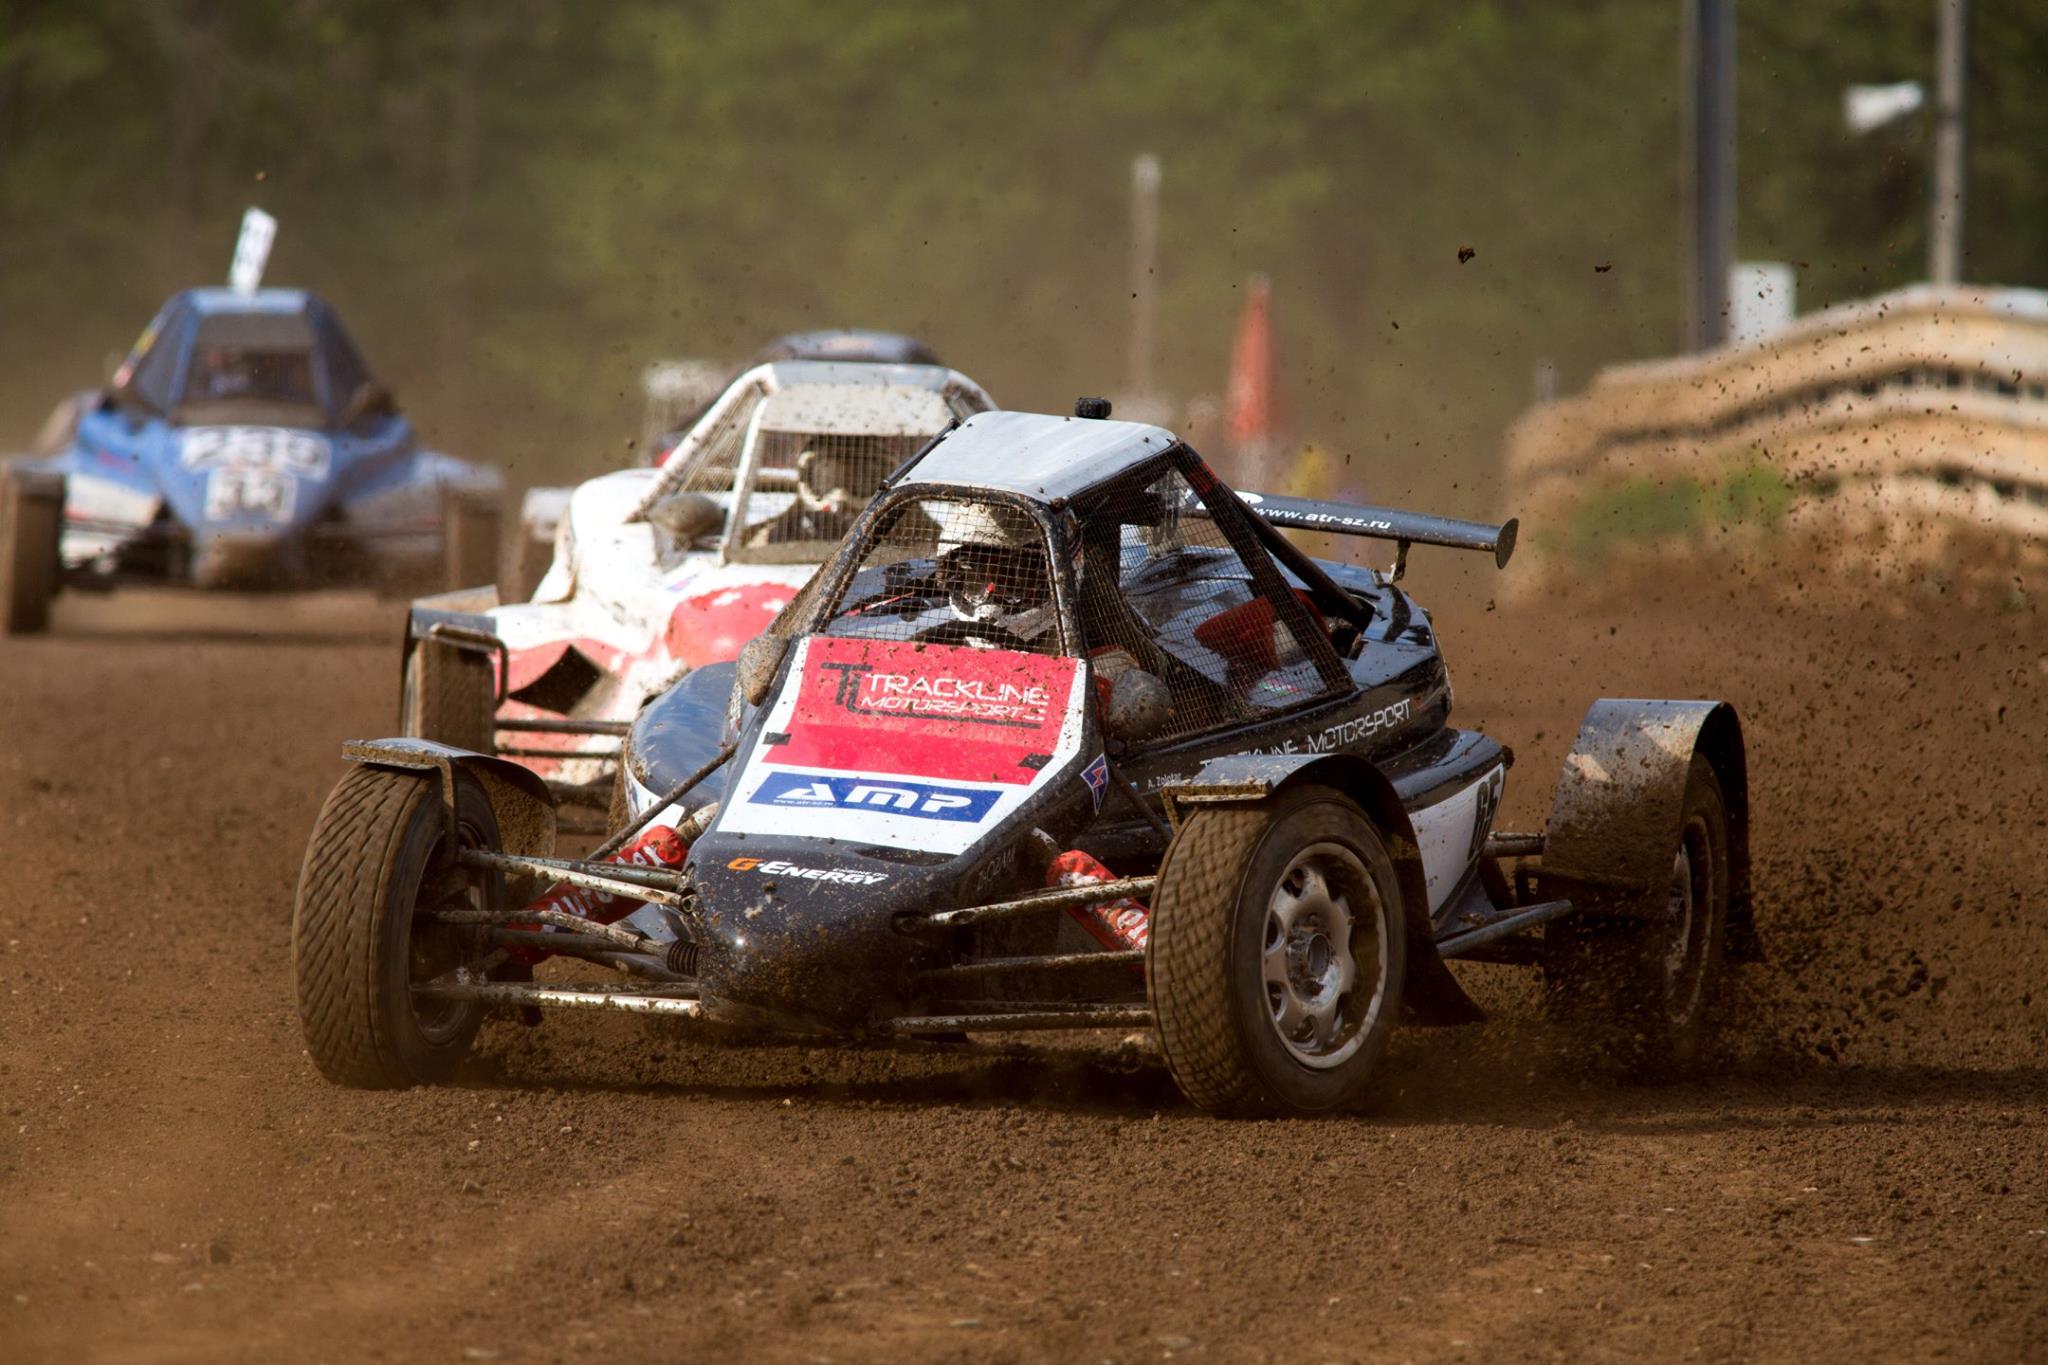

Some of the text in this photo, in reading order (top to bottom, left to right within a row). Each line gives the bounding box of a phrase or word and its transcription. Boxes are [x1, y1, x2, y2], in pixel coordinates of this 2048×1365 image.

[1253, 507, 1391, 529] www.atr-sz.ru
[865, 673, 1050, 706] TRACKLINE
[861, 696, 1024, 719] MOTORSPORT
[1308, 698, 1411, 754] MOTORSPORT
